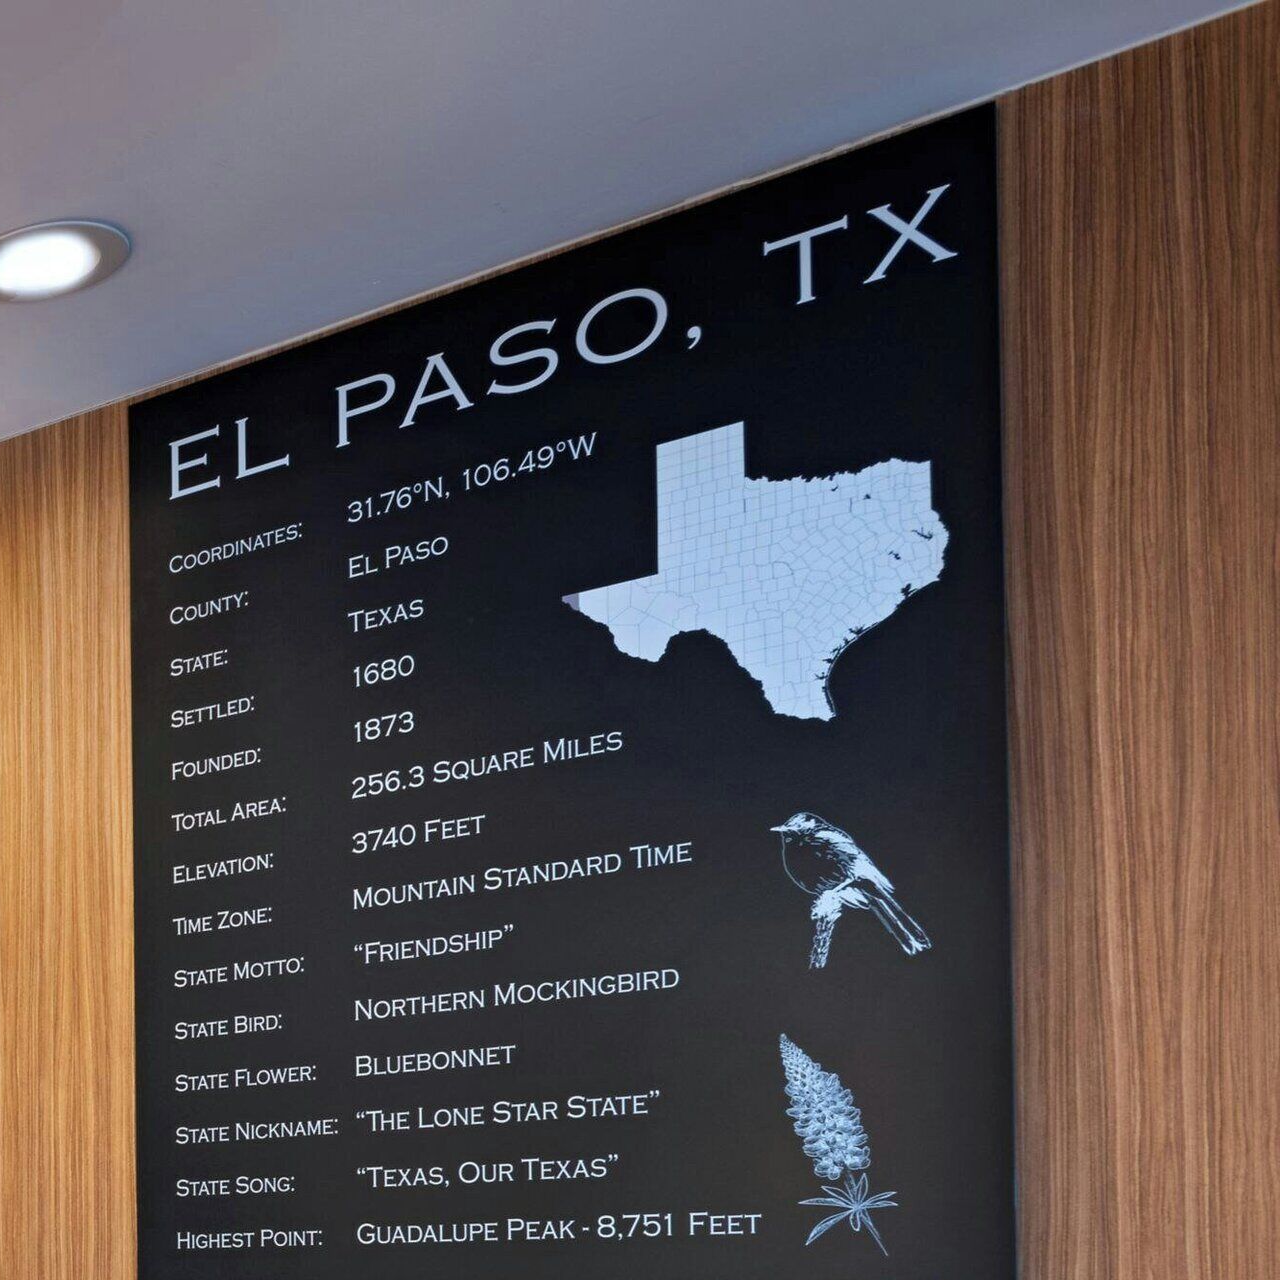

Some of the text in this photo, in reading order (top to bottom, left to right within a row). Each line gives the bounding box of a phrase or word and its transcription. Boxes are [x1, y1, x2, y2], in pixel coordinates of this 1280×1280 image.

[168, 184, 959, 501] EL PASO, TX
[353, 654, 415, 688] 1680
[354, 710, 415, 743] 1873
[351, 765, 425, 800] 256.3
[351, 823, 417, 854] 3740
[596, 1213, 673, 1241] 8,751
